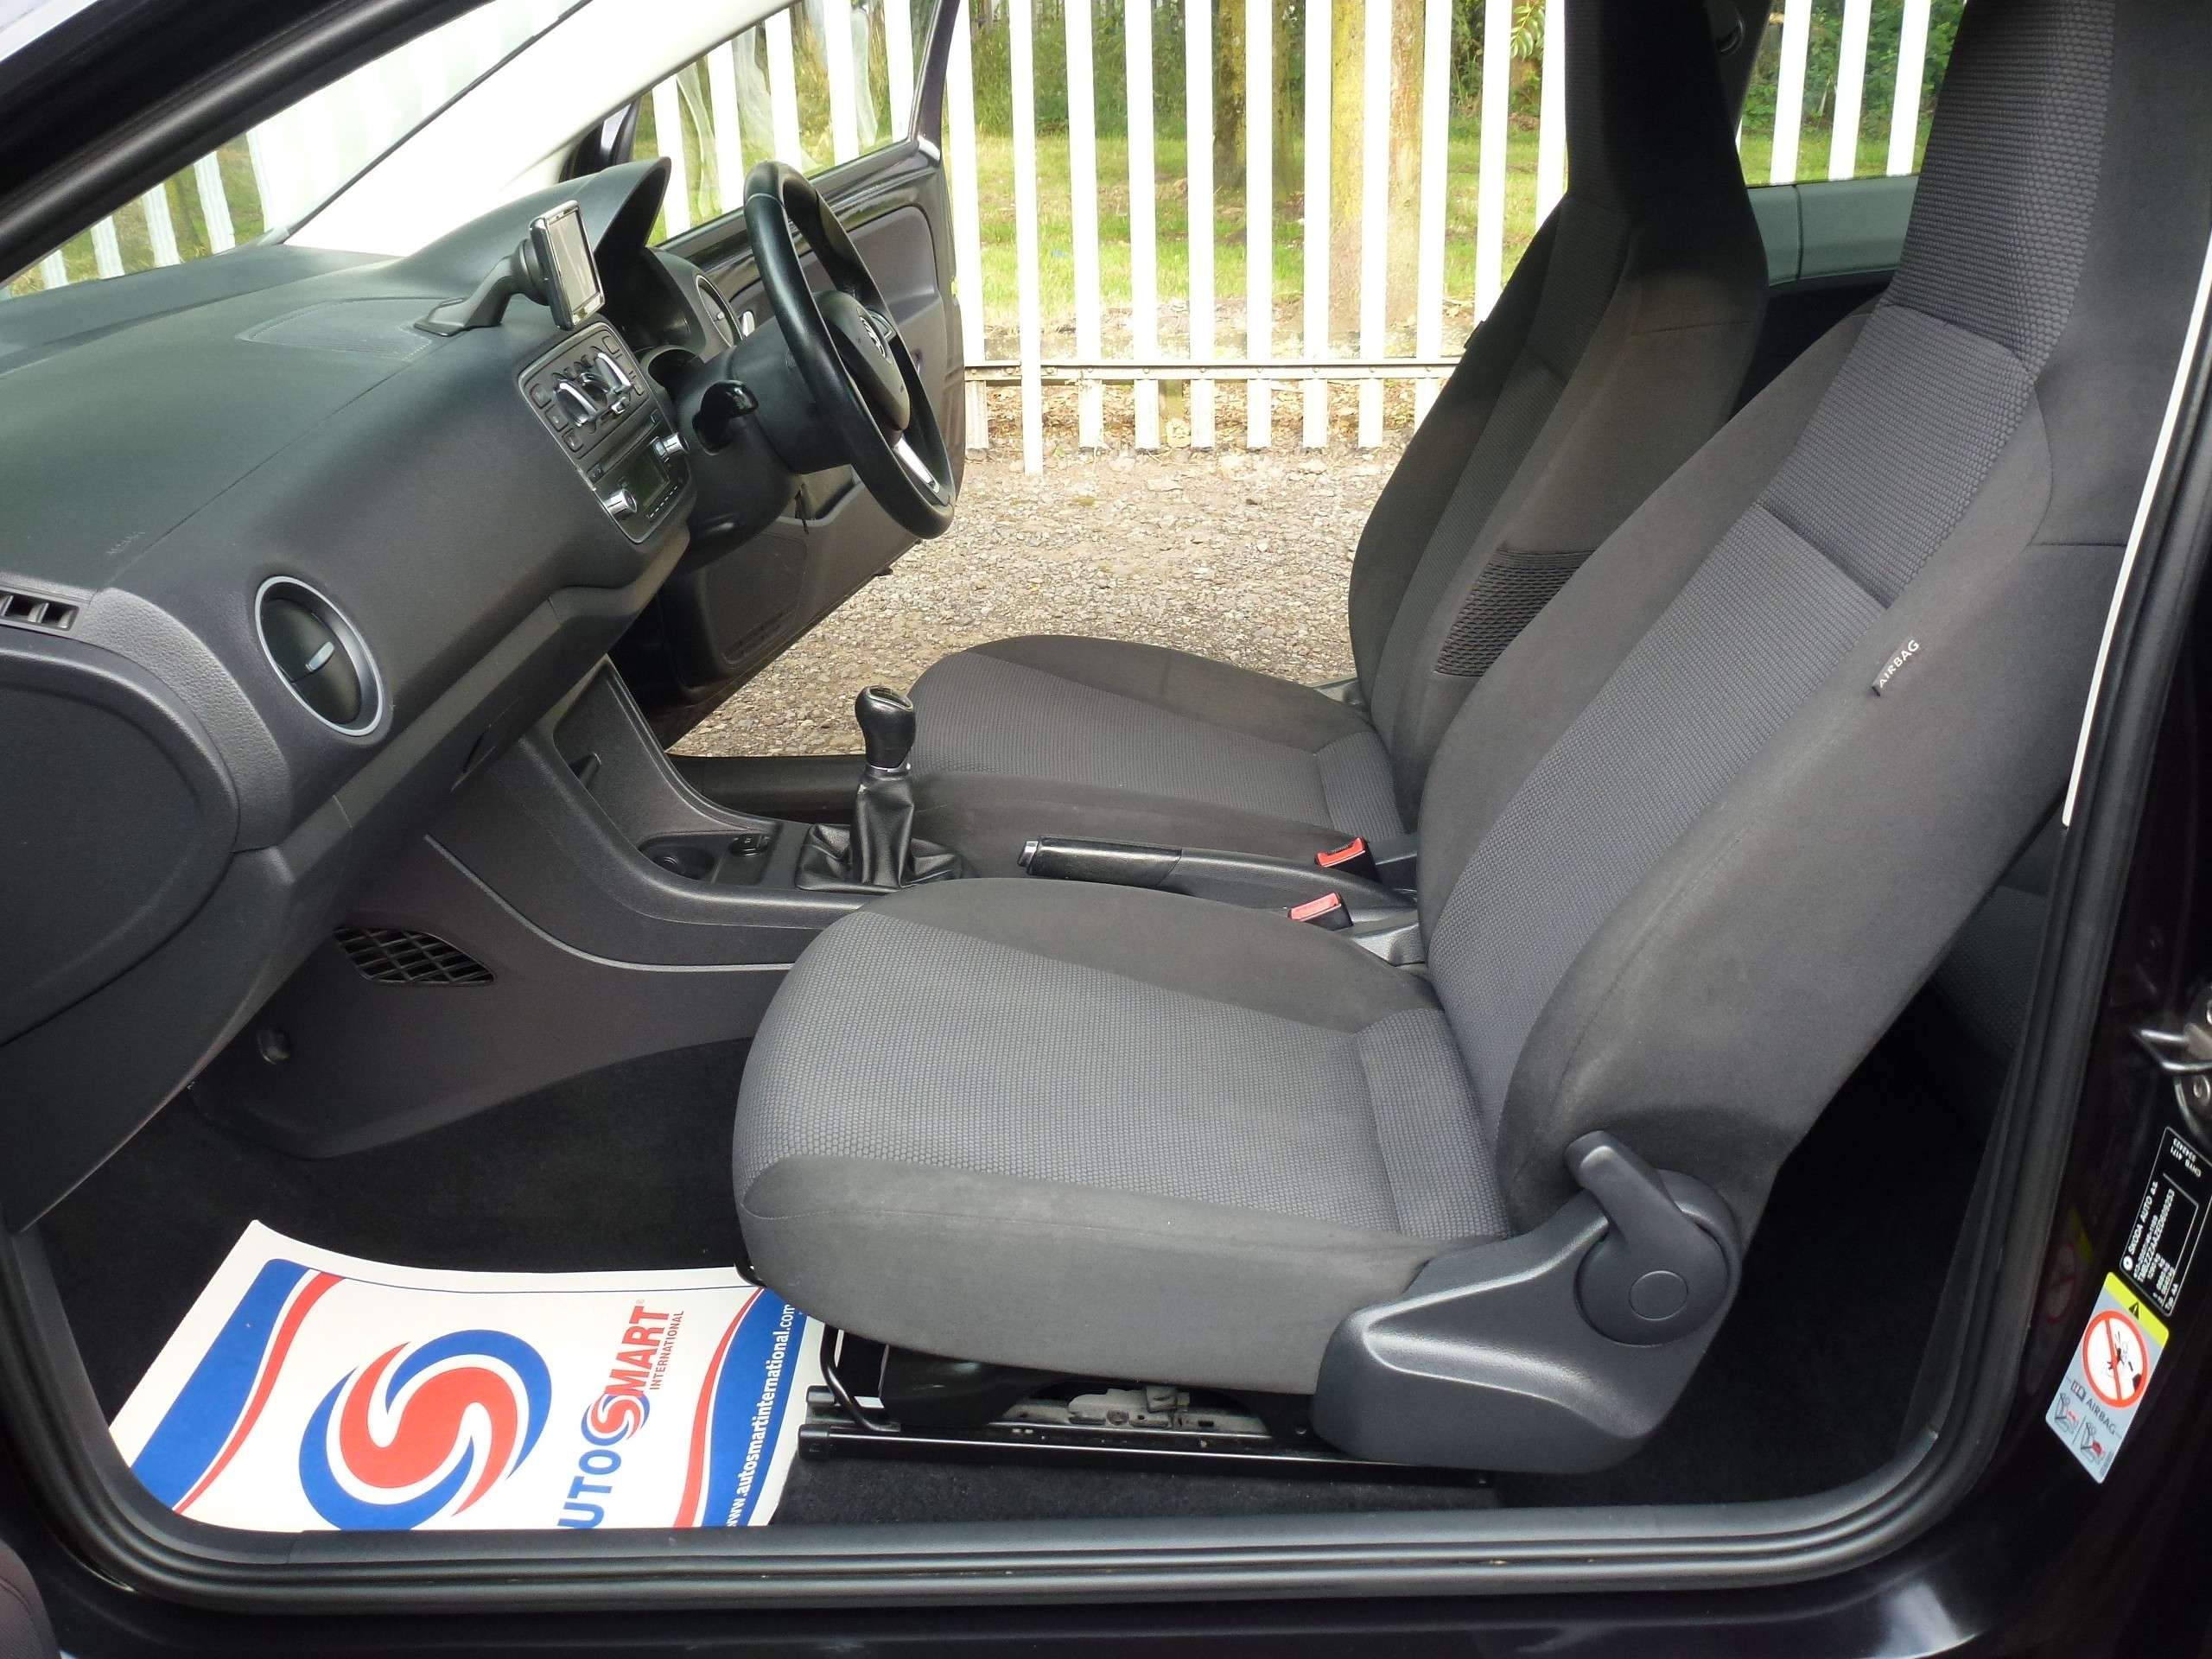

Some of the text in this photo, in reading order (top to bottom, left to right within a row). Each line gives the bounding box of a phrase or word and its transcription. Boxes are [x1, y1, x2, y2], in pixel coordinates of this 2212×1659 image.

[1878, 639, 1919, 689] AIRBAG
[649, 1310, 685, 1390] INTERNATIONAL
[2086, 1397, 2117, 1435] AIRBAG
